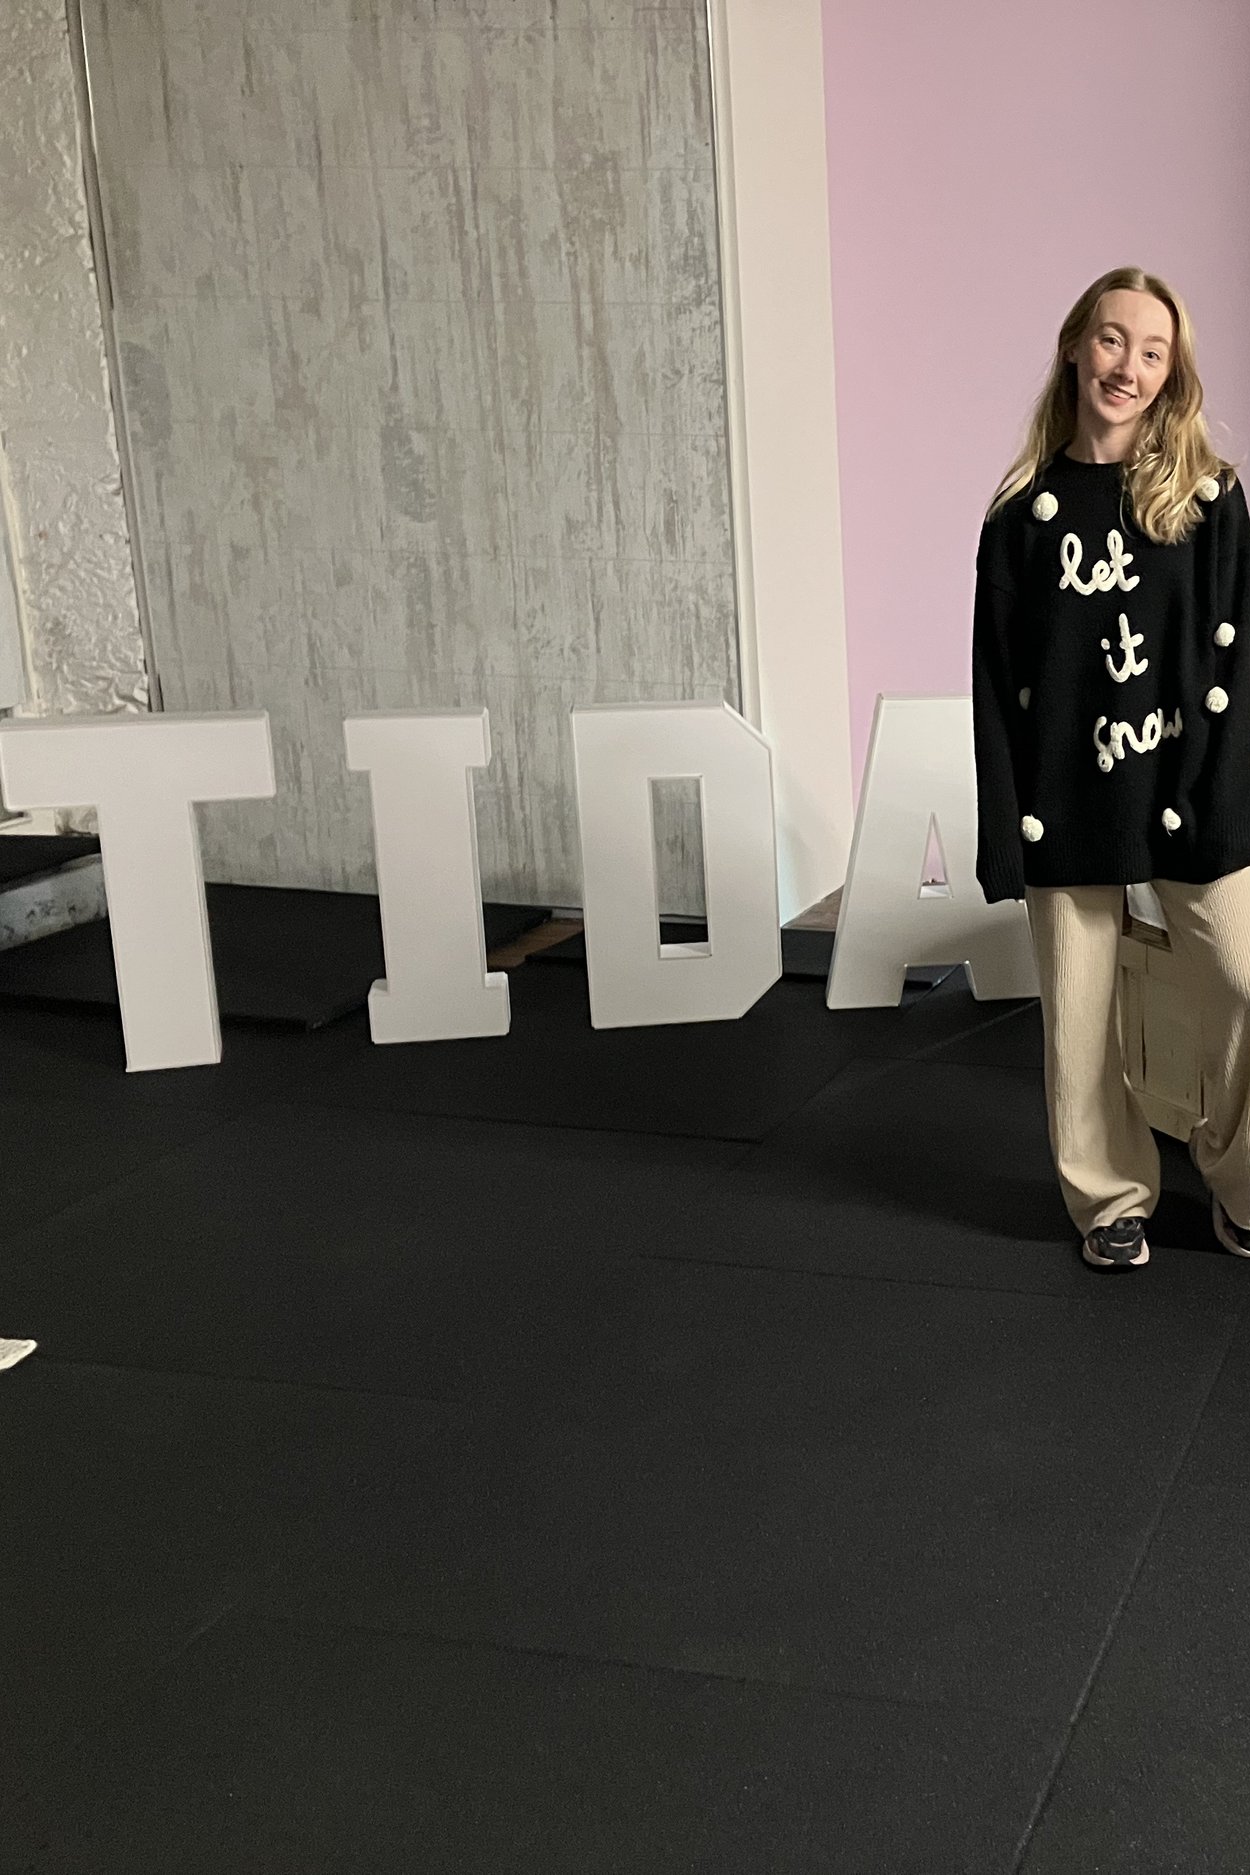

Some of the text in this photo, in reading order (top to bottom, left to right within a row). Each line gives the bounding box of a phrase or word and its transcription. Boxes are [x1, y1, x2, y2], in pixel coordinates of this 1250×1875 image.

[1059, 529, 1140, 596] let
[1100, 613, 1149, 683] it
[1093, 707, 1183, 773] snow
